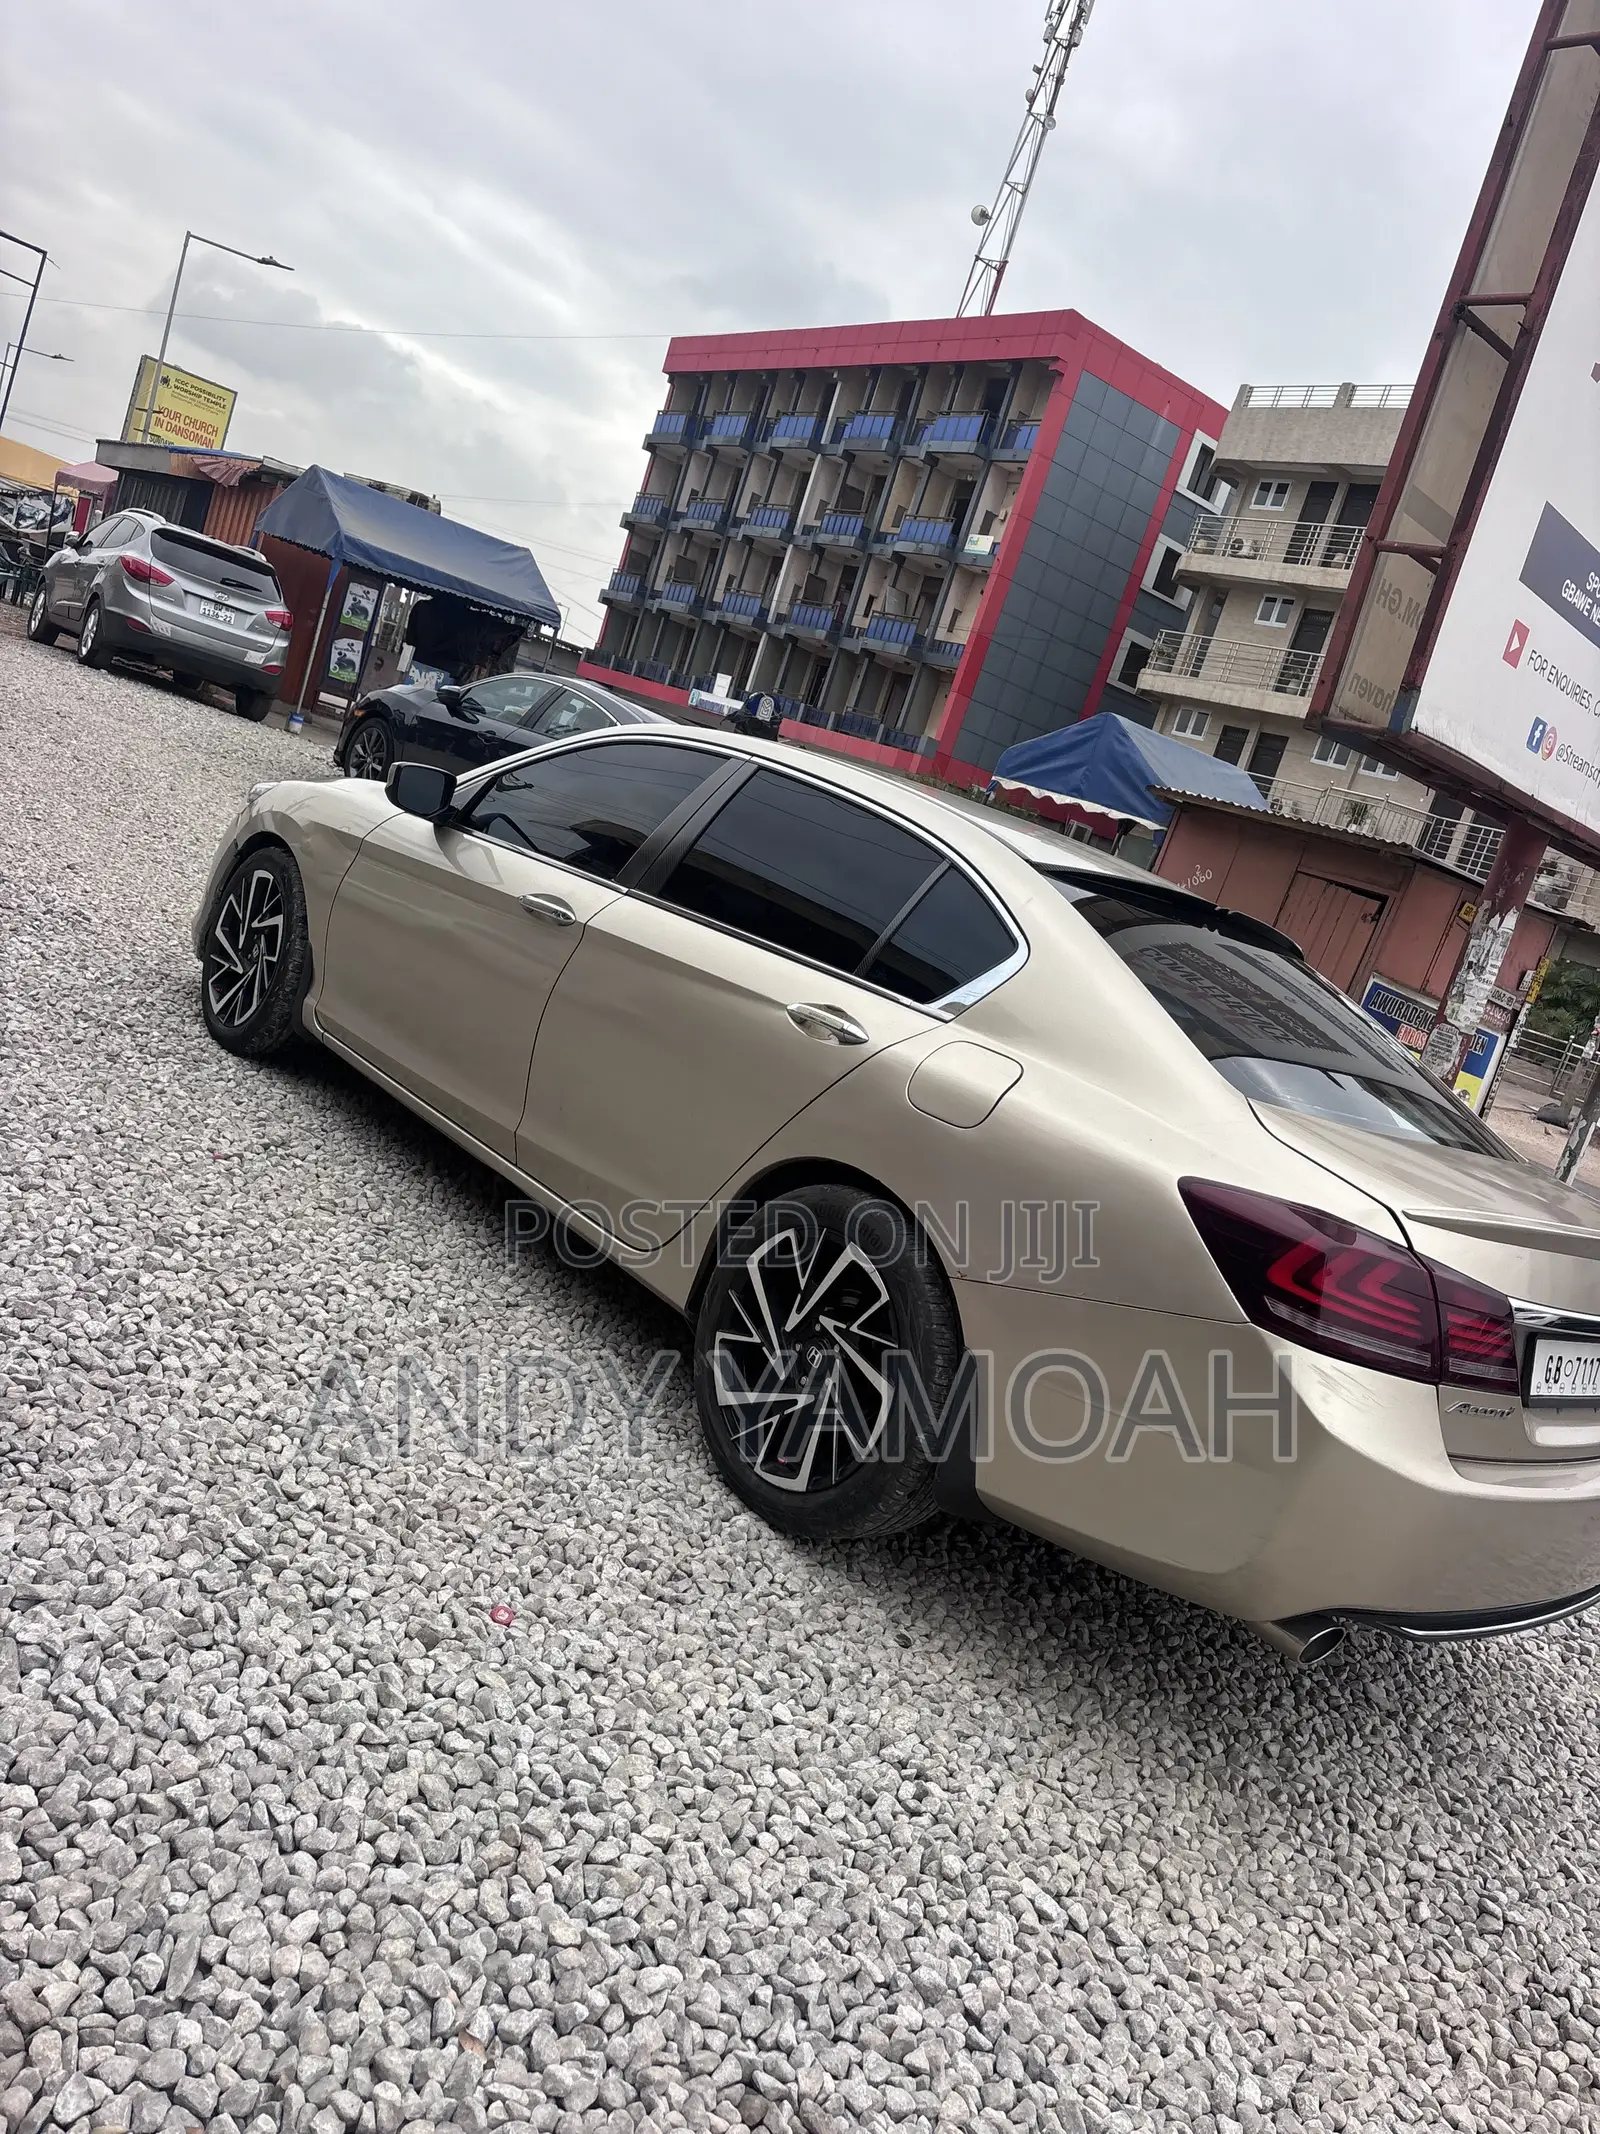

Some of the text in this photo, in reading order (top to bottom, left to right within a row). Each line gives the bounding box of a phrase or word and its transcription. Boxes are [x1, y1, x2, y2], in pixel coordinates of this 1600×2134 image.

[173, 383, 203, 399] WORSHIP
[203, 396, 227, 410] TEMPLE
[174, 377, 227, 402] ICGC POSSIBILITY
[153, 416, 215, 449] IN DANSOMAN
[157, 405, 219, 437] YOUR CHURCH
[1561, 578, 1593, 617] GBAWE
[1527, 649, 1549, 678] FOR
[1546, 664, 1593, 714] ENQUIRIES,
